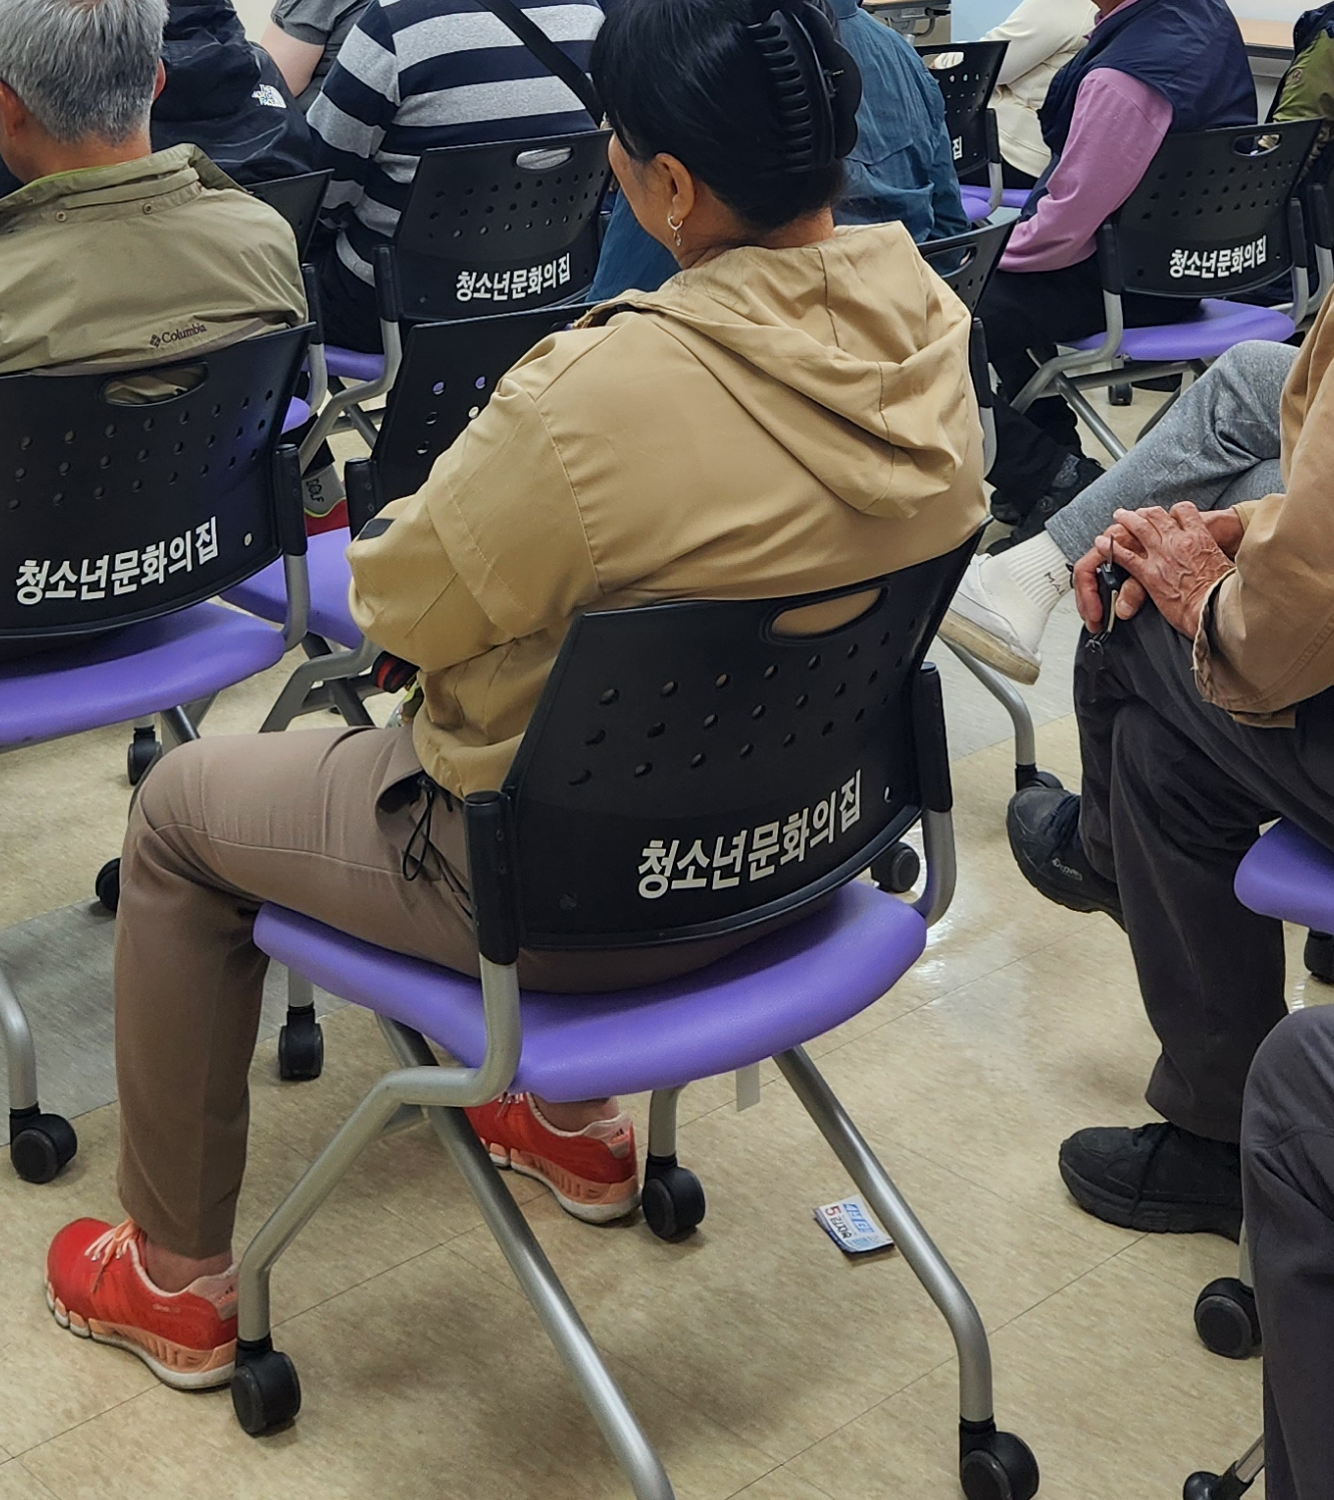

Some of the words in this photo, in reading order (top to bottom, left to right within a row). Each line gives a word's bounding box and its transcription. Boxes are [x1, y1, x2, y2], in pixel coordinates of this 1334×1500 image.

[455, 253, 571, 301] 청소년문화의집
[1169, 235, 1267, 280] 청소년문화의집
[161, 322, 207, 344] Columbia
[15, 516, 219, 605] 청소년문화의집
[637, 769, 863, 899] 청소년문화의집
